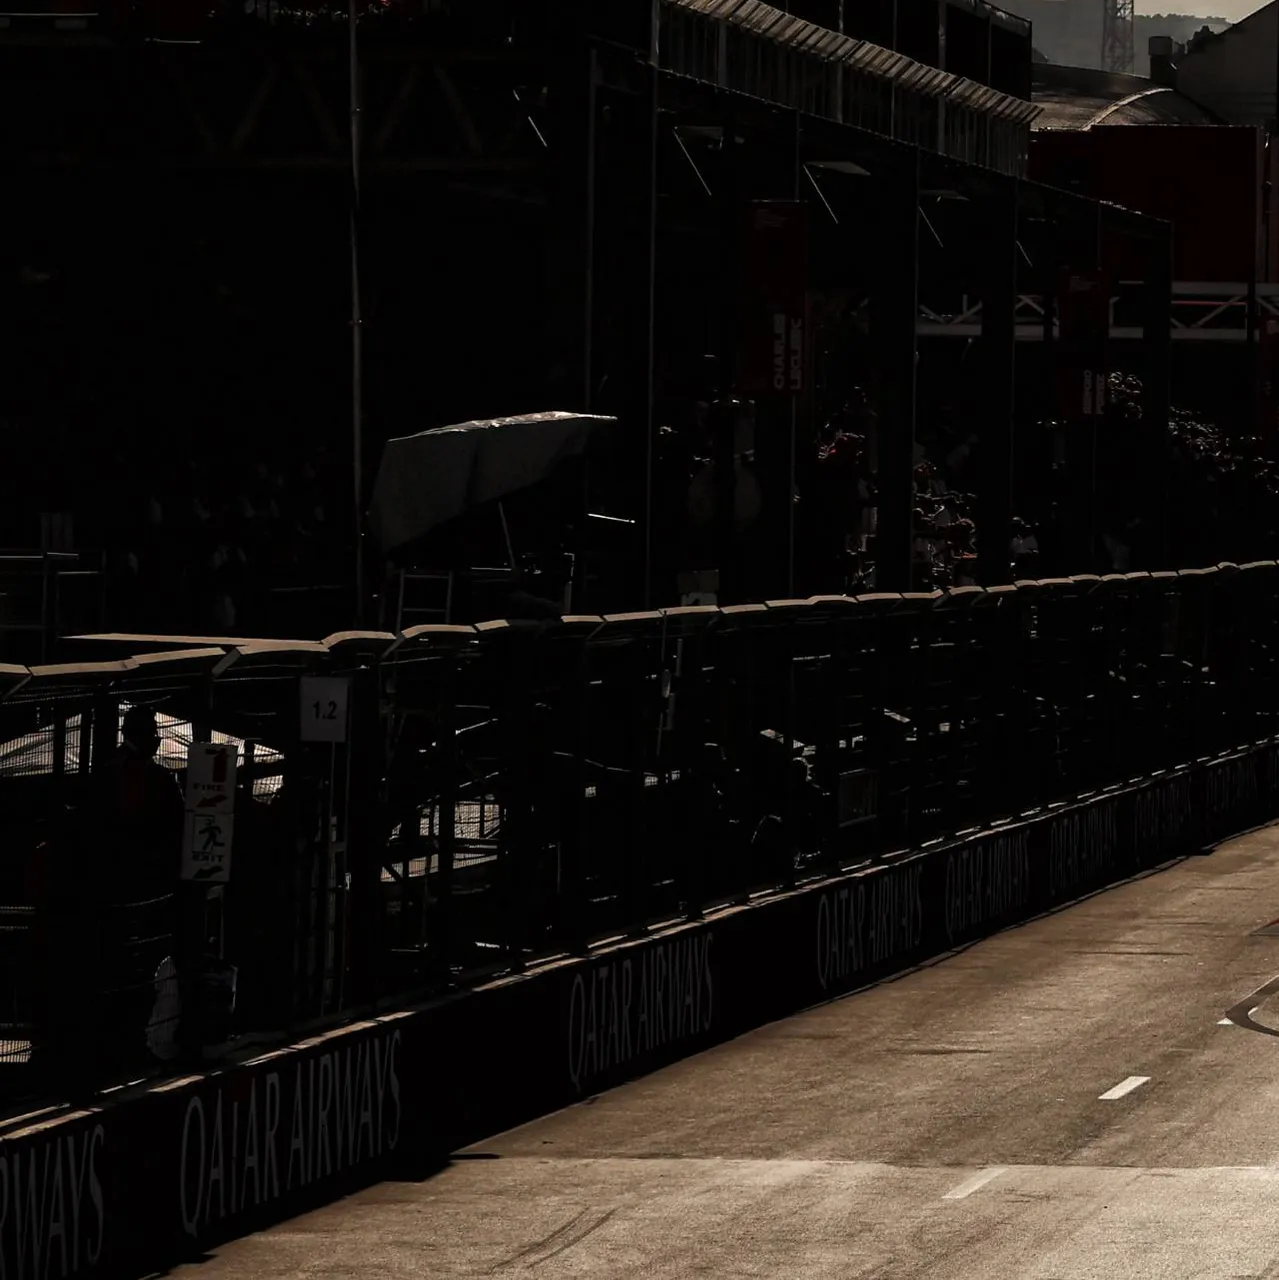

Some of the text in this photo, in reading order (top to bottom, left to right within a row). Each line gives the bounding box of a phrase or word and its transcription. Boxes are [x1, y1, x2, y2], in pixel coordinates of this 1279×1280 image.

[312, 700, 337, 720] 1.2
[568, 932, 713, 1093] QATAR AIRWAYS
[286, 1028, 401, 1192] AIRWAYS
